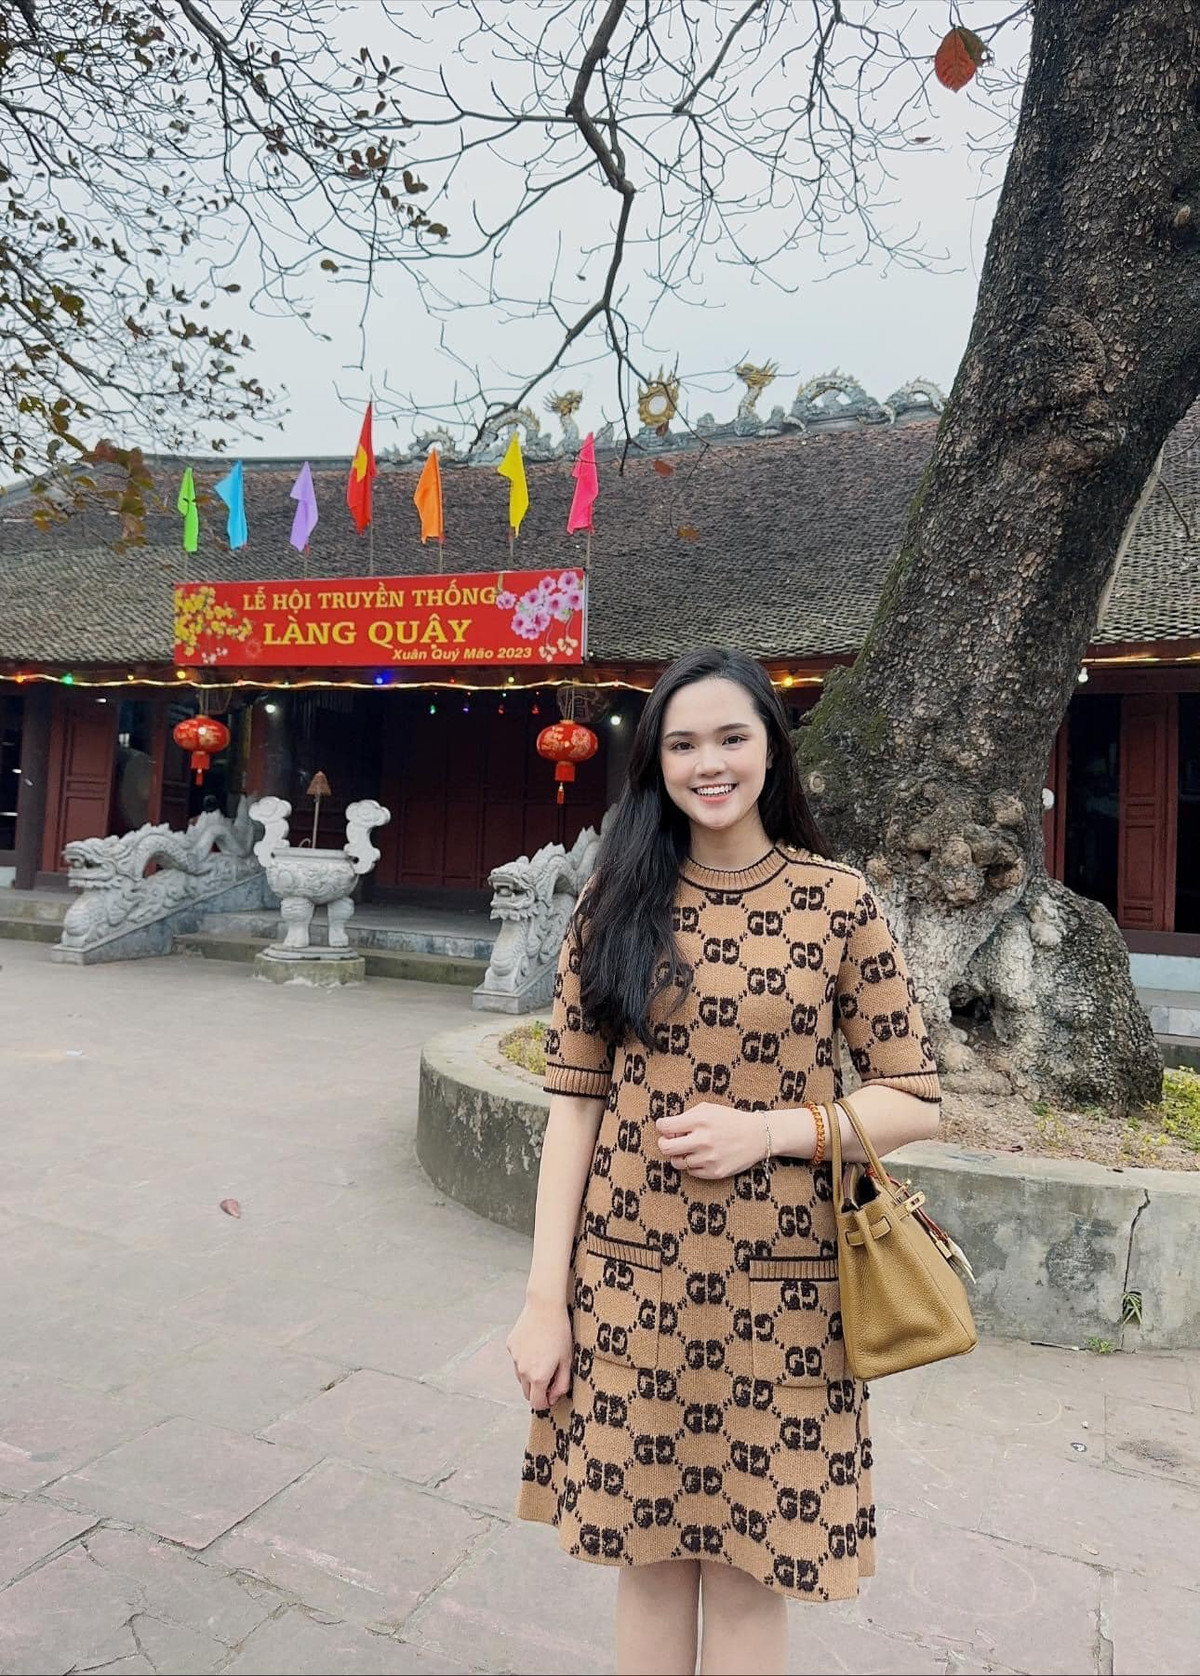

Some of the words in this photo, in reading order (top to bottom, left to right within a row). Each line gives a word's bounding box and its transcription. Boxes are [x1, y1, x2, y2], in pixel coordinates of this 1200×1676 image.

[243, 586, 266, 610] LỄ
[272, 588, 311, 614] HỘI
[317, 581, 405, 609] TRUYỀN
[412, 578, 497, 607] THỐNG
[263, 615, 357, 645] LÀNG
[368, 613, 472, 650] QUẬY
[392, 649, 427, 660] Xuân
[431, 648, 459, 662] Quý
[463, 648, 494, 660] Mão
[497, 647, 532, 659] 2023
